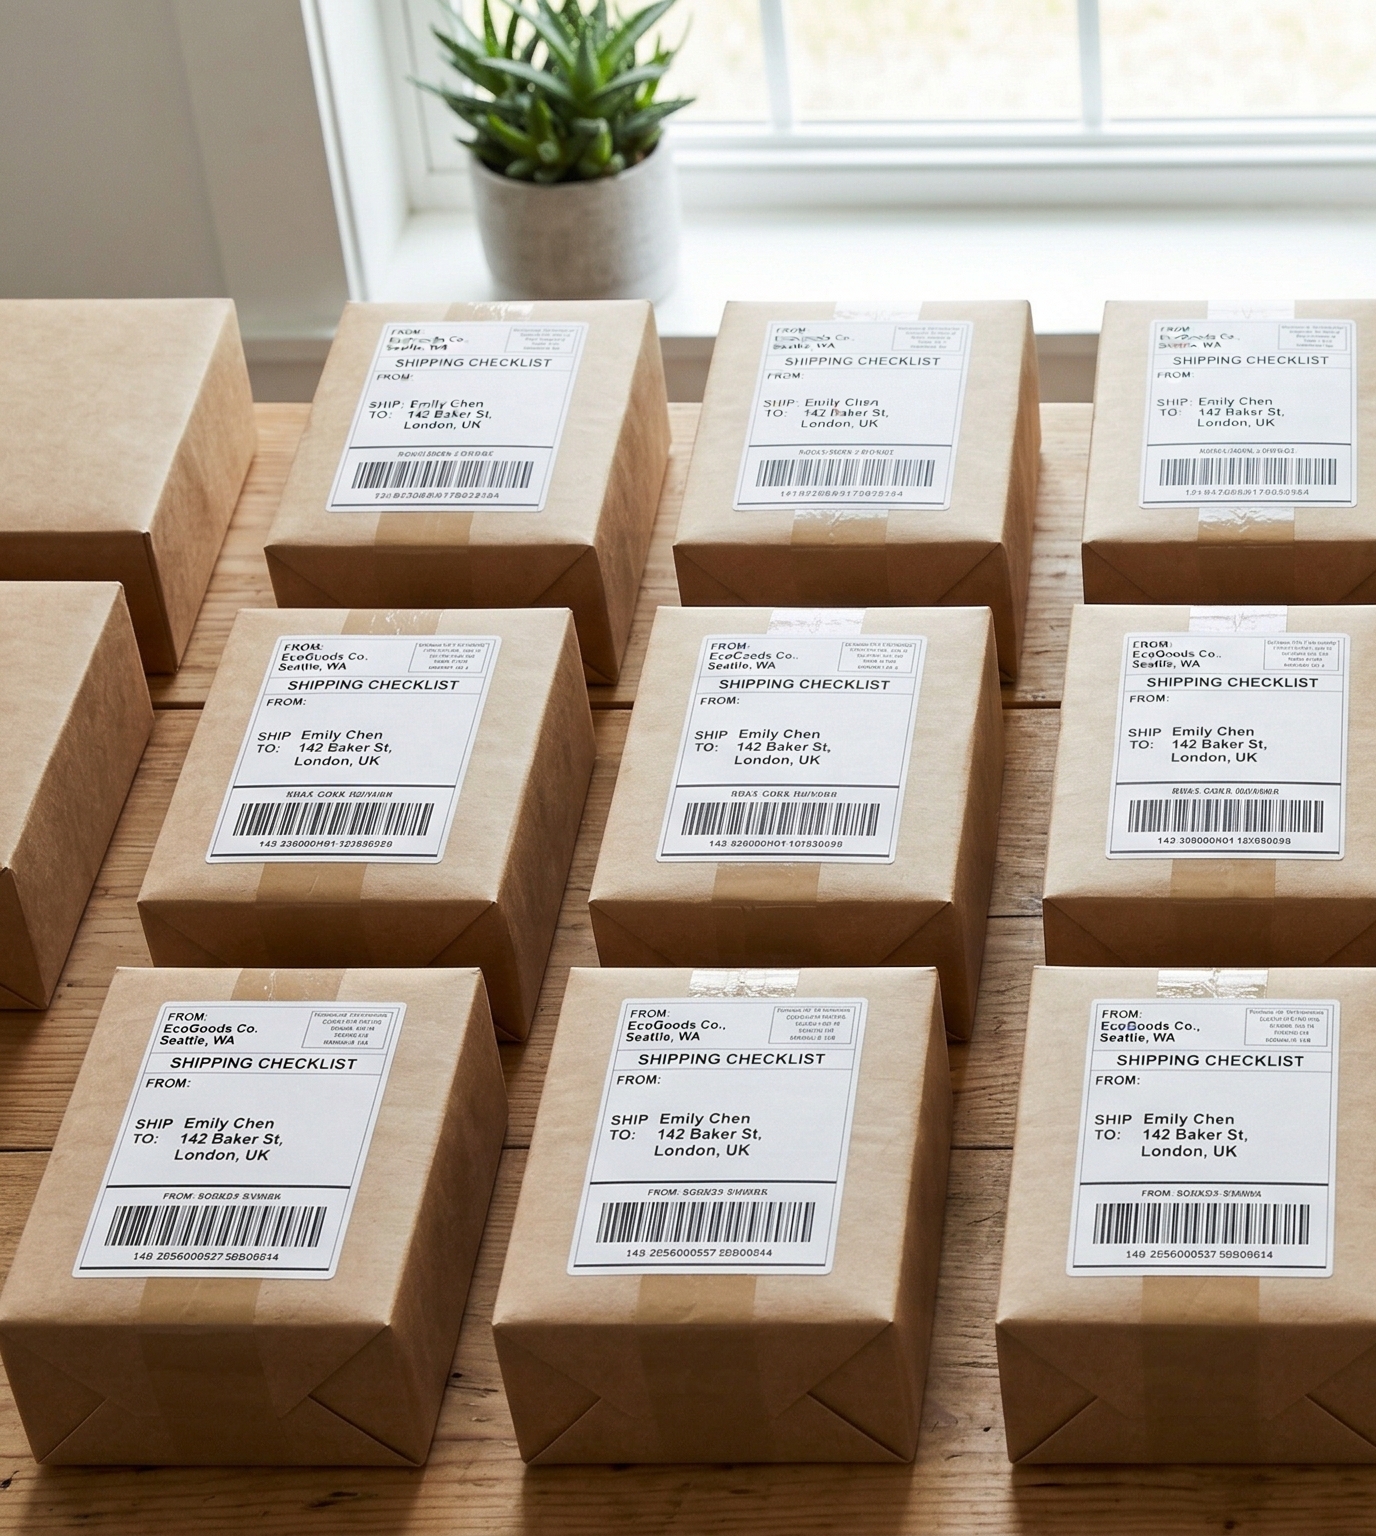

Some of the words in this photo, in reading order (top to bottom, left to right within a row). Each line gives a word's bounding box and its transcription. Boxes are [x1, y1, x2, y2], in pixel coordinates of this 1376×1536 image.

[396, 359, 463, 367] SHIPPING
[469, 359, 552, 367] CHECKLIST
[785, 357, 852, 365] SHIPPING
[858, 357, 940, 365] CHECKLIST
[1174, 356, 1241, 365] SHIPPING
[1247, 356, 1328, 364] CHECKLIST
[288, 680, 363, 690] SHIPPING
[369, 680, 459, 690] CHECKLIST
[719, 679, 794, 689] SHIPPING
[800, 679, 890, 689] CHECKLIST
[1147, 677, 1222, 687] SHIPPING
[1228, 678, 1318, 687] CHECKLIST
[301, 730, 341, 742] Emily
[346, 730, 382, 739] Chen
[739, 729, 778, 741] Emily
[784, 729, 820, 738] Chen
[1173, 727, 1212, 738] Emily
[1217, 727, 1254, 736] Chen
[300, 743, 323, 752] 142
[328, 743, 370, 752] Baker
[374, 743, 391, 753] St,
[738, 742, 761, 751] 142
[767, 742, 808, 751] Baker
[813, 742, 830, 753] St,
[1173, 739, 1196, 748] 142
[1202, 739, 1244, 748] Baker
[1249, 740, 1267, 750] St,
[294, 756, 352, 767] London,
[359, 756, 380, 765] UK
[735, 755, 793, 766] London,
[799, 755, 820, 764] UK
[1172, 752, 1230, 763] London,
[1236, 753, 1257, 762] UK
[168, 1013, 207, 1021] FROM:
[631, 1010, 669, 1018] FROM:
[1102, 1010, 1141, 1018] FROM:
[164, 1024, 232, 1033] EcoGoods
[628, 1020, 696, 1030] EcoGoods
[214, 1036, 234, 1044] WA
[679, 1032, 700, 1040] WA
[1153, 1033, 1175, 1042] WA
[170, 1057, 252, 1068] SHIPPING
[259, 1058, 357, 1069] CHECKLIST
[638, 1054, 720, 1065] SHIPPING
[727, 1054, 825, 1064] CHECKLIST
[1117, 1055, 1199, 1066] SHIPPING
[1206, 1055, 1304, 1066] CHECKLIST
[146, 1079, 191, 1088] FROM:
[617, 1075, 660, 1084] FROM:
[1096, 1076, 1139, 1085] FROM:
[135, 1119, 173, 1129] SHIP
[184, 1118, 229, 1131] Emily
[234, 1118, 274, 1129] Chen
[611, 1115, 648, 1125] SHIP
[660, 1113, 704, 1127] Emily
[709, 1113, 750, 1124] Chen
[1095, 1115, 1132, 1125] SHIP
[1144, 1113, 1188, 1127] Emily
[1194, 1114, 1234, 1124] Chen
[134, 1134, 158, 1143] TO:
[181, 1133, 208, 1144] 142
[212, 1133, 259, 1144] Baker
[263, 1134, 282, 1146] St,
[610, 1130, 635, 1140] TO:
[658, 1129, 685, 1140] 142
[690, 1128, 737, 1139] Baker
[742, 1128, 761, 1140] St,
[1095, 1129, 1120, 1140] TO:
[1144, 1129, 1170, 1140] 142
[1176, 1129, 1222, 1140] Baker
[1228, 1129, 1247, 1142] St,
[175, 1149, 238, 1162] London,
[246, 1150, 270, 1160] UK
[654, 1145, 719, 1158] London,
[727, 1144, 750, 1156] UK
[1142, 1145, 1207, 1159] London,
[1214, 1145, 1237, 1157] UK
